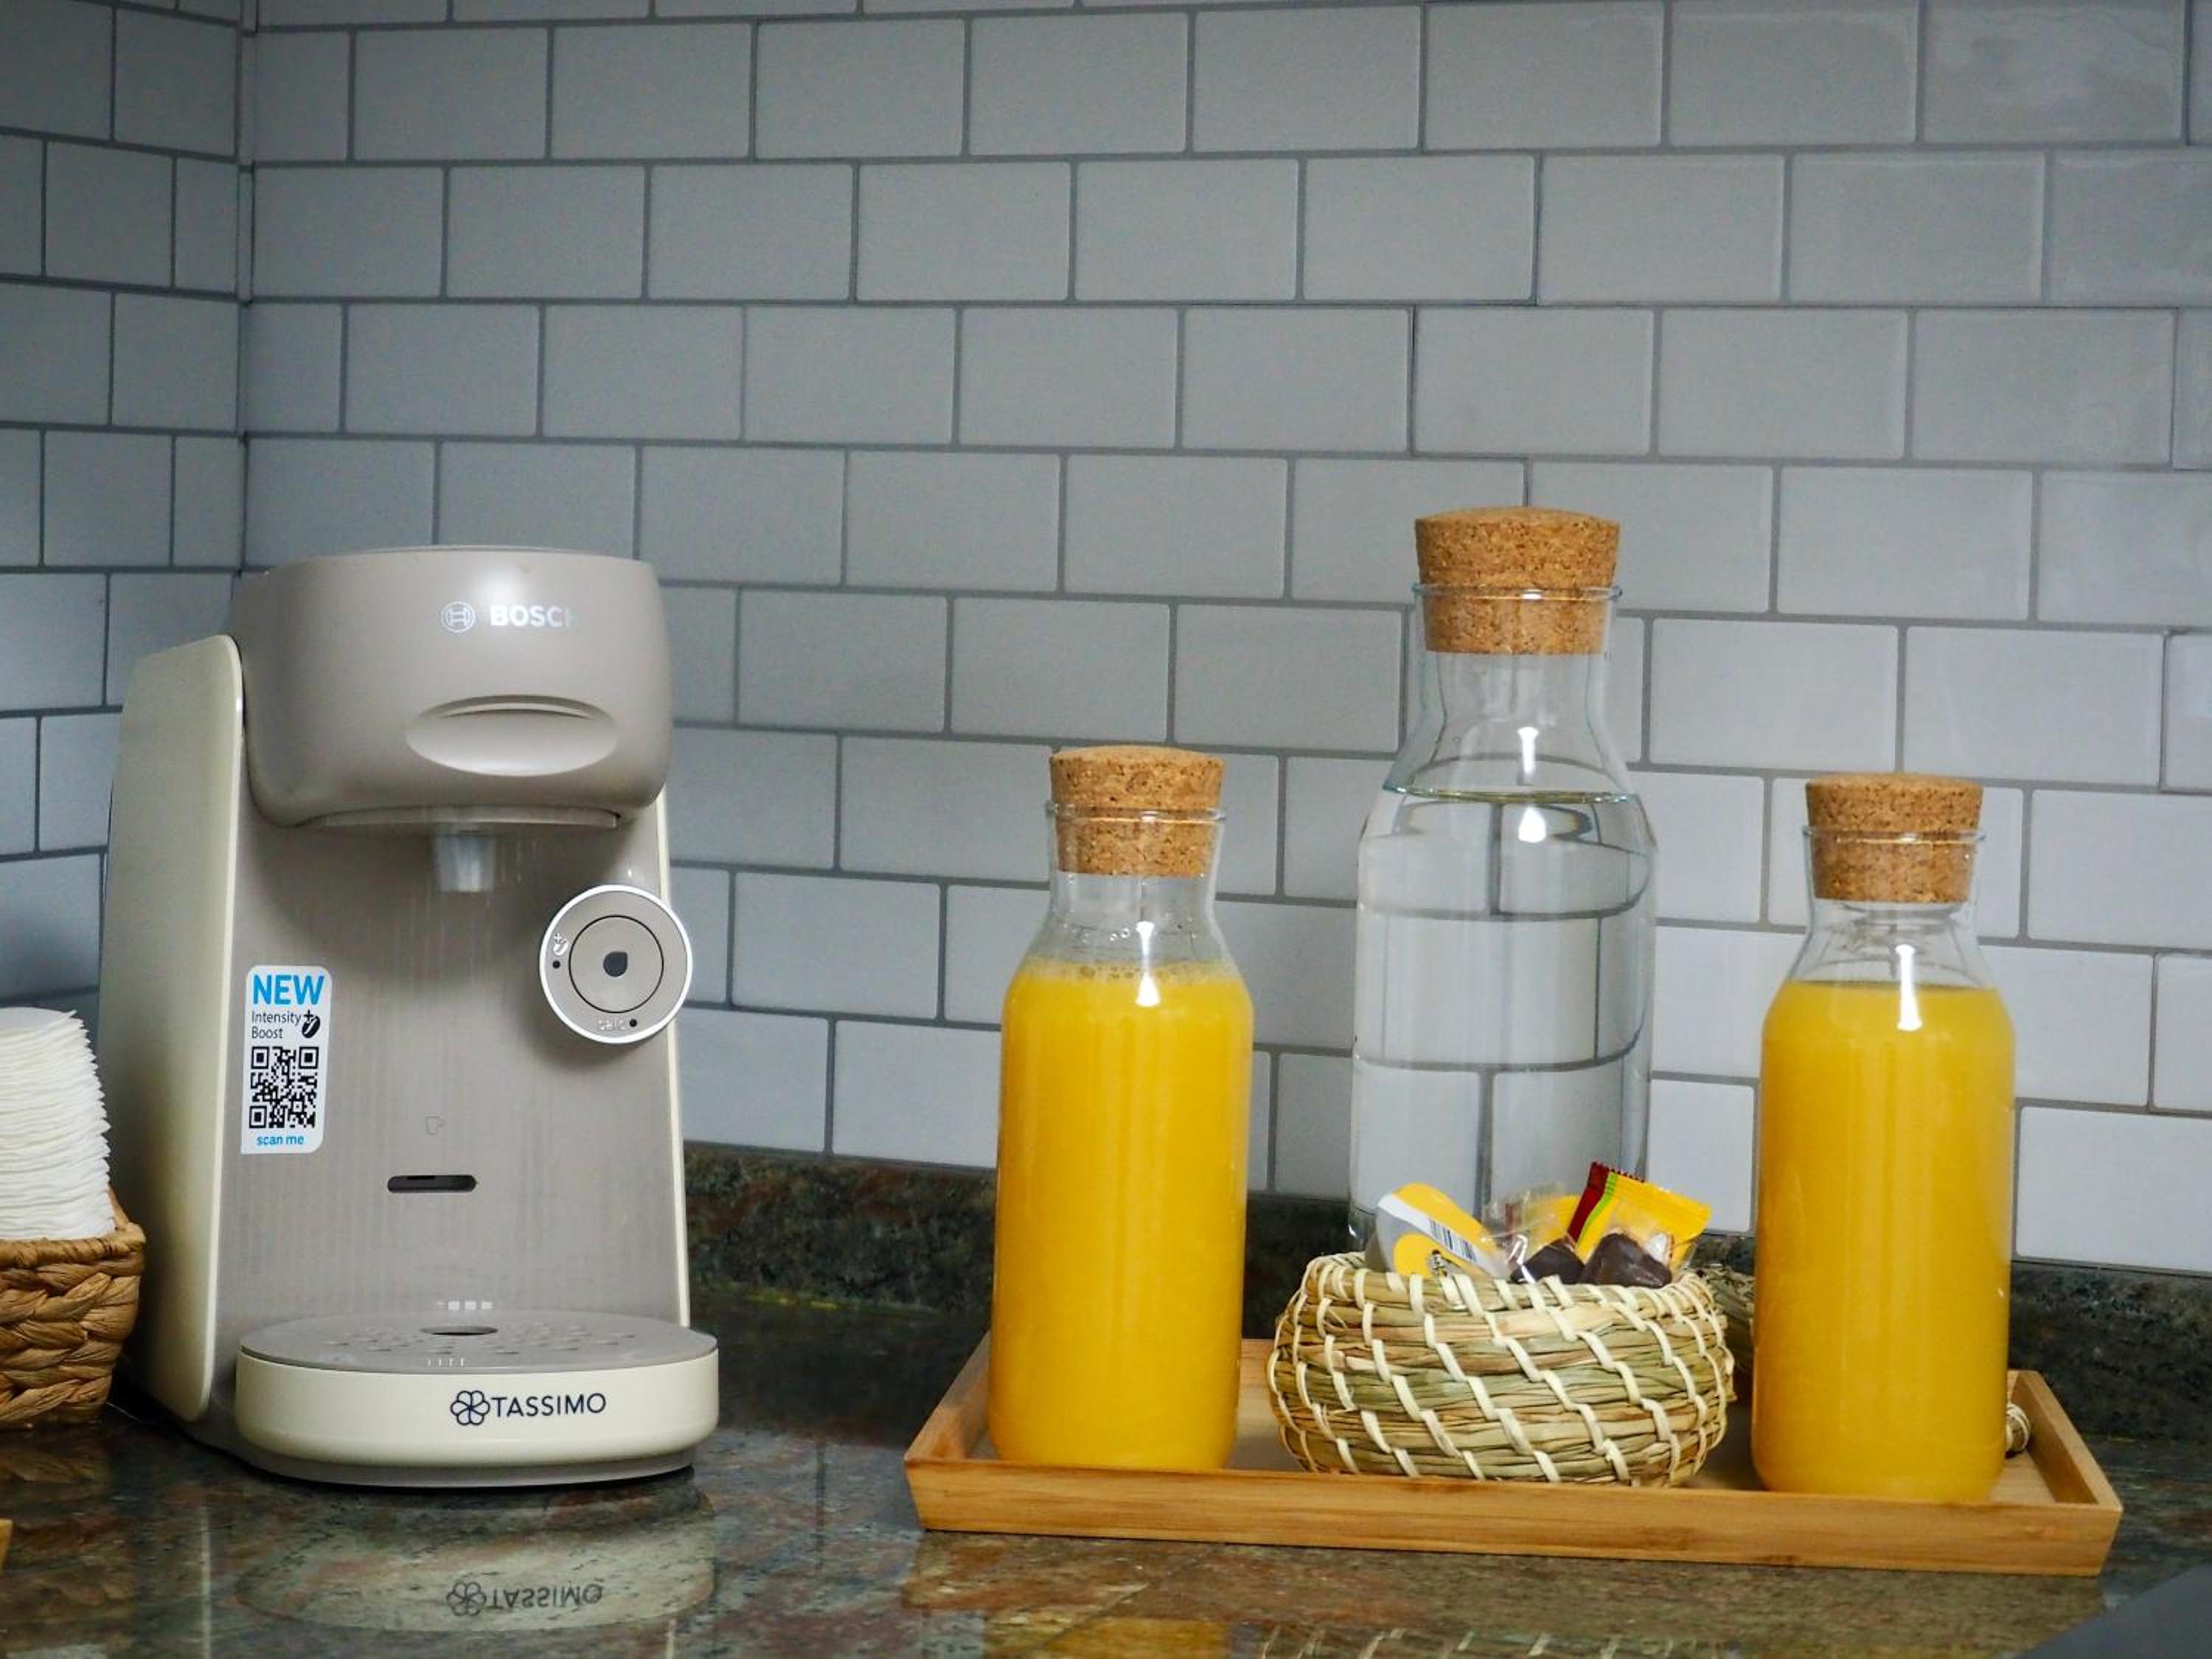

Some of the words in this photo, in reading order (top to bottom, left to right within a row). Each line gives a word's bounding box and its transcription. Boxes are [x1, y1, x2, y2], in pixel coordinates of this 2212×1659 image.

[490, 605, 576, 627] BOSC
[252, 974, 325, 1006] NEW
[251, 1010, 302, 1026] Intensity
[251, 1026, 284, 1039] Boost
[257, 1135, 285, 1146] scan
[285, 1133, 305, 1145] me
[490, 1392, 606, 1418] TASSIMO
